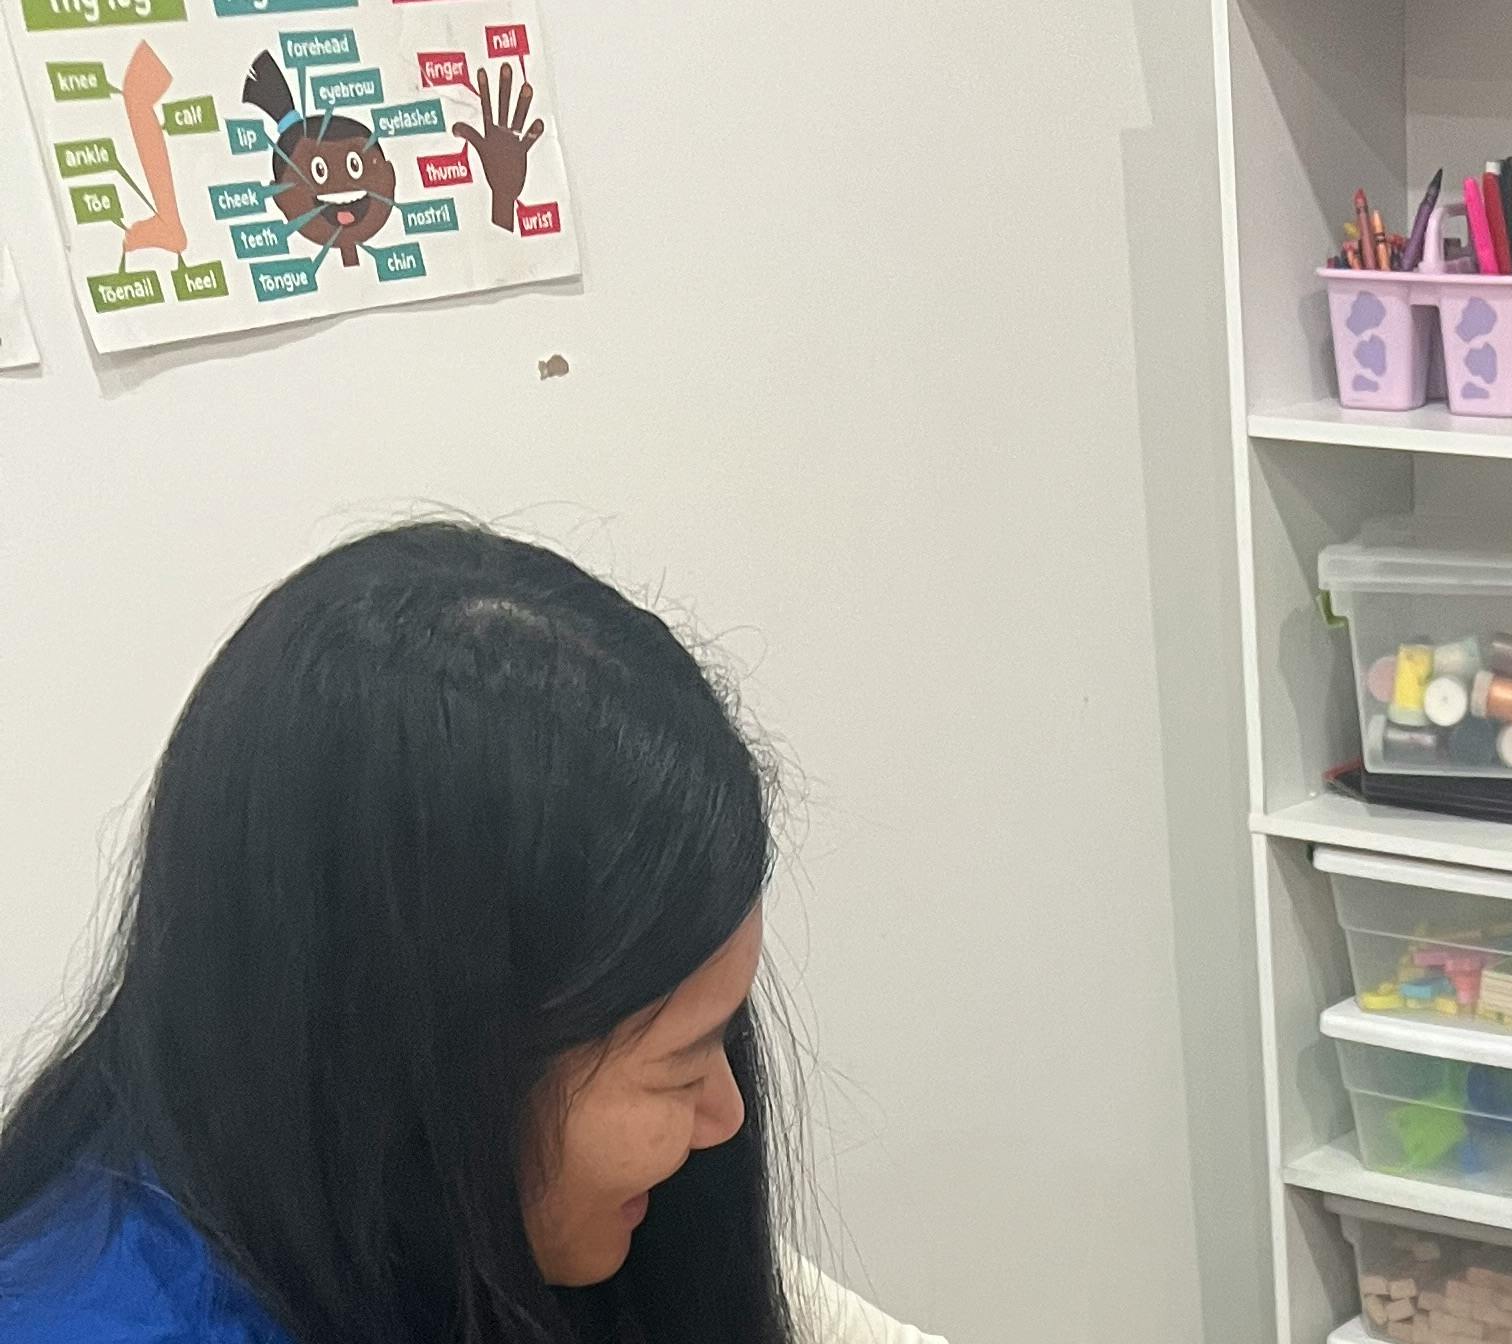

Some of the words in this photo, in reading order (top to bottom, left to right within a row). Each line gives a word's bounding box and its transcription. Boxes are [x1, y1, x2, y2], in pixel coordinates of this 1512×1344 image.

[287, 34, 350, 57] forehead
[492, 29, 517, 50] nail
[57, 71, 98, 92] knee
[425, 61, 465, 80] finger
[319, 80, 375, 104] eyebrow
[174, 104, 203, 127] calf
[379, 109, 438, 135] eyelashes
[237, 127, 257, 149] lip
[65, 143, 110, 167] ankle
[426, 161, 468, 182] thumb
[83, 193, 111, 213] toe
[218, 188, 259, 210] cheek
[408, 204, 451, 228] nostril
[522, 211, 554, 231] wrist
[241, 228, 279, 250] teeth
[387, 248, 417, 271] chin
[98, 277, 155, 304] toenail
[185, 270, 218, 293] heel
[259, 271, 309, 294] tongue
